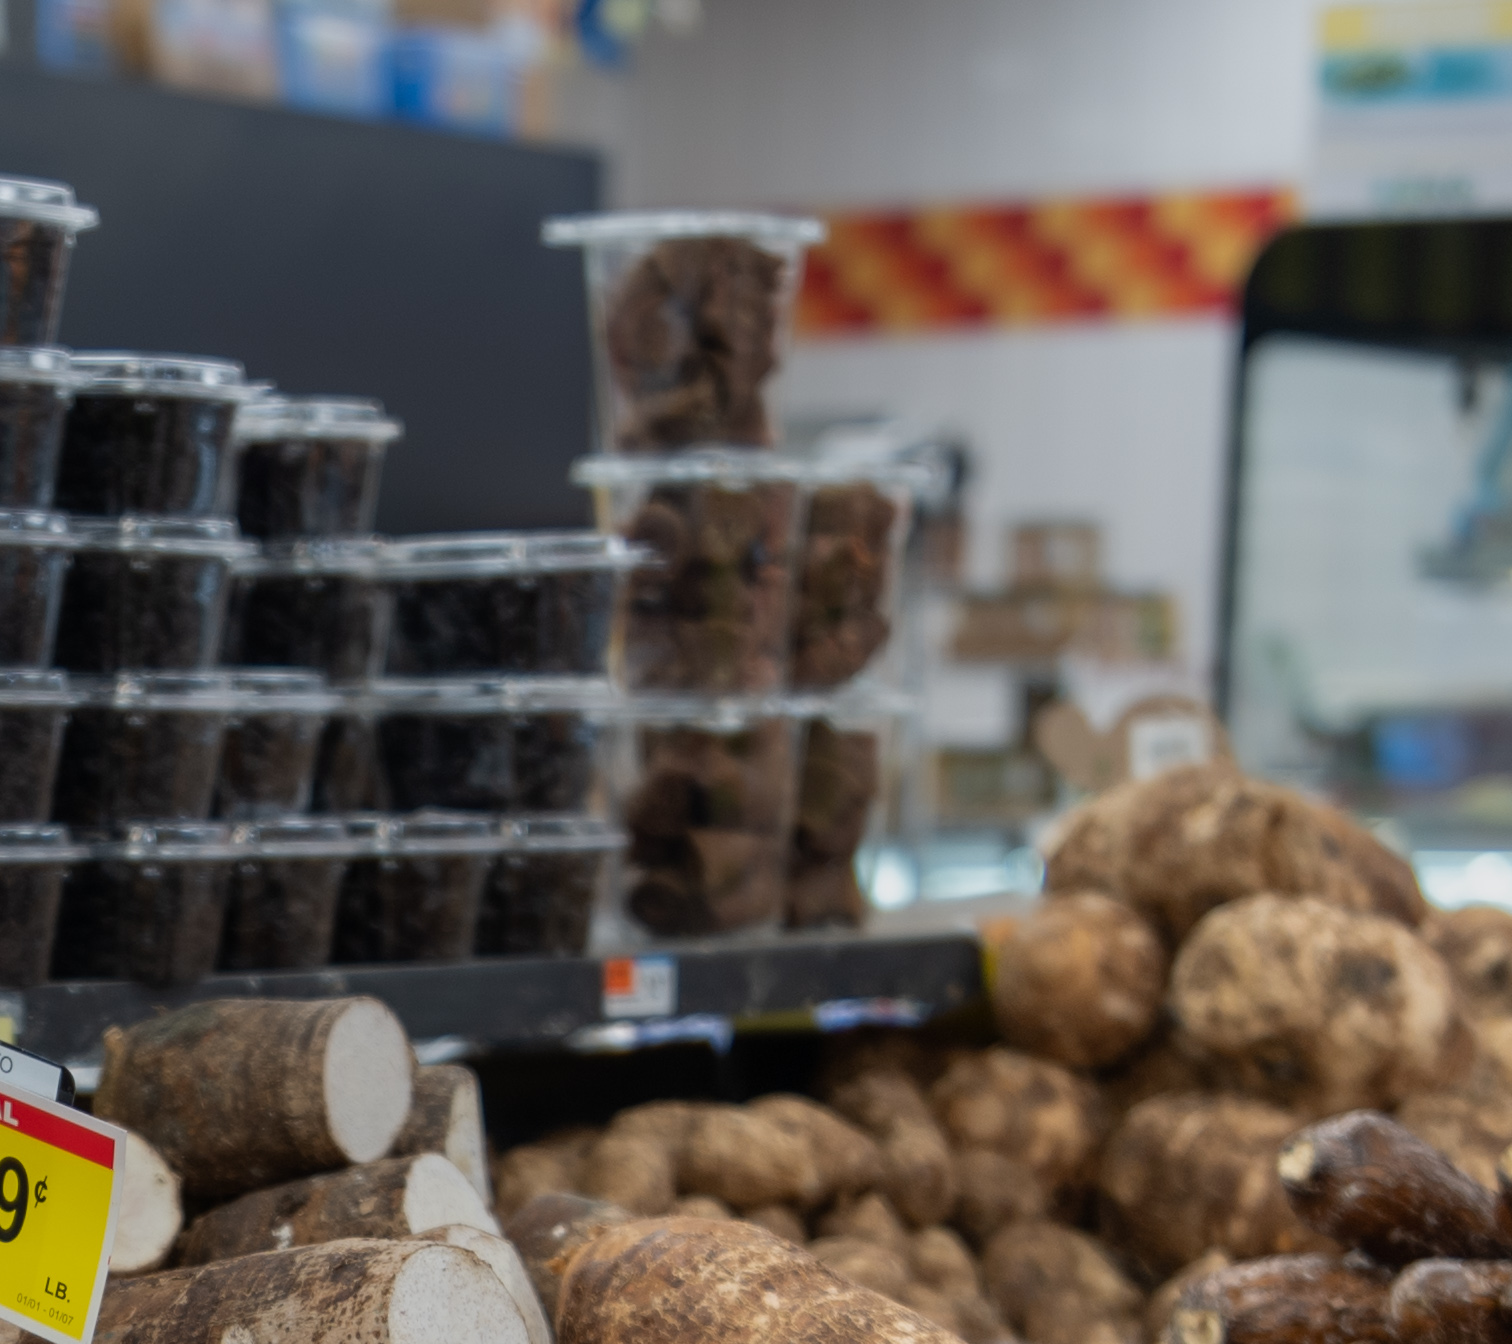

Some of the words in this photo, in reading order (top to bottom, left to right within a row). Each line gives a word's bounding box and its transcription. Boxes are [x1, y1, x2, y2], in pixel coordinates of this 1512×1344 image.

[44, 1276, 70, 1303] LB.
[16, 1292, 41, 1312] 01/01
[48, 1307, 74, 1326] 01/07
